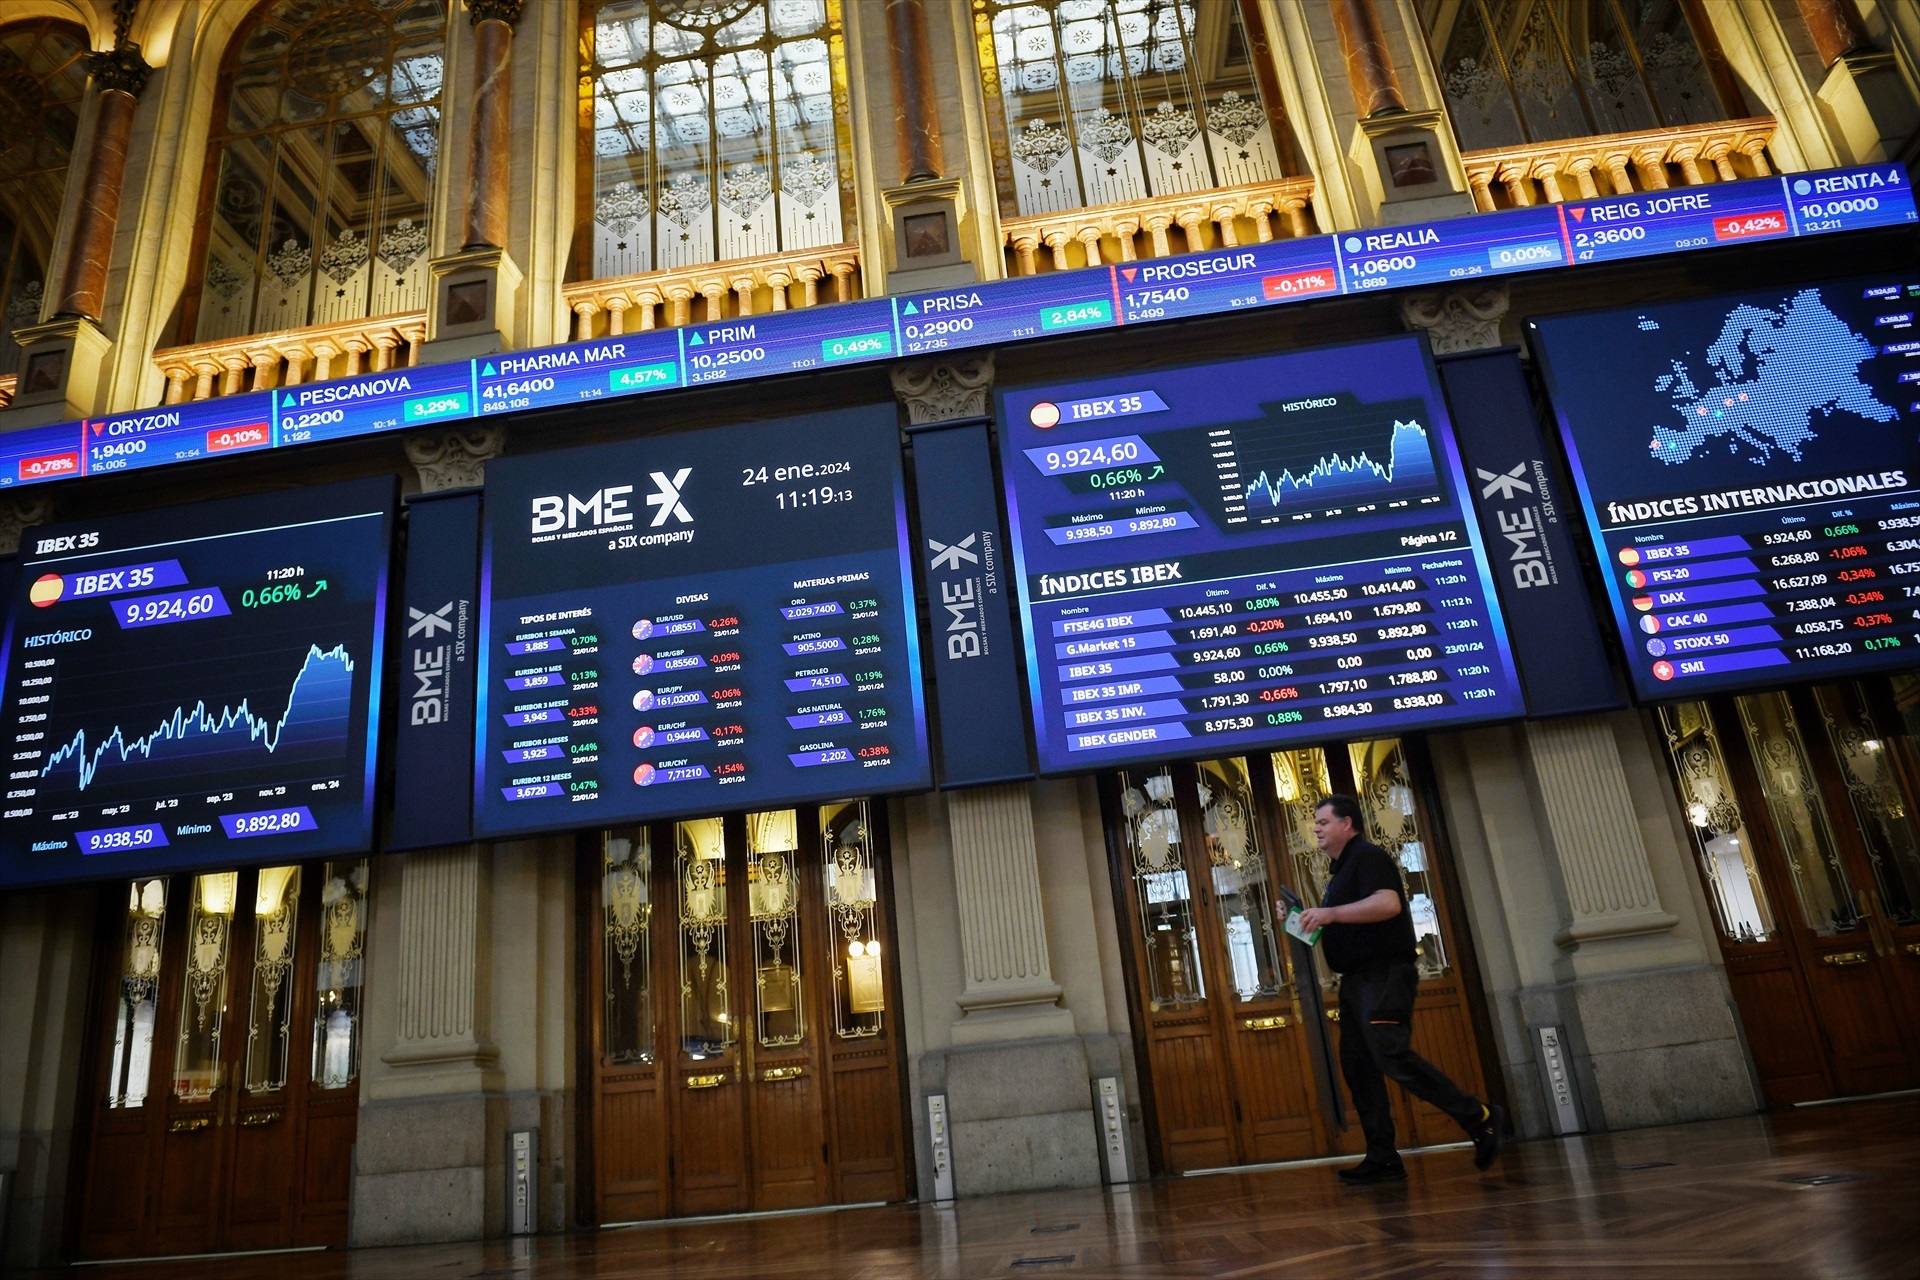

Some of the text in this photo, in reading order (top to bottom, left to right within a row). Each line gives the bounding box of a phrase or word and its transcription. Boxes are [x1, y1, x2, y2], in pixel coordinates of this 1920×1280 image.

[1814, 169, 1900, 194] RENTA 4
[1590, 193, 1712, 222] REIG JOFRE
[1800, 197, 1879, 218] 10,0000
[1721, 217, 1780, 235] -0,42%
[1804, 219, 1842, 232] 13.211
[1366, 228, 1440, 252] REALIA
[1575, 226, 1646, 248] 2,3600
[1675, 237, 1708, 248] 09:00
[1500, 246, 1552, 264] 0,00%
[1579, 250, 1594, 260] 47
[1142, 253, 1256, 282] PROSEGUR
[1349, 256, 1416, 277] 1,0600
[1449, 266, 1482, 277] 09:24
[1273, 275, 1326, 293] -0,11%
[923, 292, 983, 314] PRISA
[1126, 286, 1190, 308] 1,7540
[1051, 307, 1102, 325] 2,84%
[1128, 307, 1165, 321] 5.499
[708, 325, 756, 344] PRIM
[905, 317, 974, 339] 0,2900
[833, 338, 881, 355] 0,49%
[908, 338, 949, 352] 12.735
[500, 344, 626, 375] PHARMA MAR
[690, 347, 765, 369] 10,2500
[620, 369, 667, 385] 4,57%
[692, 369, 727, 382] 3.582
[300, 376, 411, 406] PESCANOVA
[482, 377, 554, 399] 41,6400
[414, 399, 460, 416] 3,29%
[1071, 397, 1142, 419] IBEX 35
[1282, 397, 1337, 412] HISTÓRICO
[108, 412, 180, 436] ORYZON
[282, 409, 344, 431] 0,2200
[214, 430, 262, 447] -0,10%
[91, 440, 147, 461] 1,9400
[1046, 442, 1138, 470] 9.924,60
[25, 459, 73, 474] -0,78%
[742, 466, 769, 486] 24
[1090, 469, 1142, 489] 0,66%
[1532, 460, 1550, 499] company
[776, 486, 853, 510] 11:19:13
[1109, 488, 1145, 501] 11:20 h
[1607, 470, 1908, 524] ÍNDICES INTERNACIONALES
[532, 485, 633, 534] BME
[1135, 505, 1166, 515] Mínimo
[1542, 501, 1555, 516] SIX
[1071, 513, 1104, 524] Máximo
[1129, 517, 1176, 532] 9.892,80
[1066, 525, 1113, 540] 9.938,50
[1634, 534, 1664, 543] Nombre
[1763, 529, 1812, 545] 9.924,60
[1824, 524, 1859, 538] 0,66%
[35, 532, 99, 554] IBEX 35
[608, 529, 694, 550] a SIX company
[1400, 530, 1457, 549] Página 1/2
[982, 531, 995, 572] company
[1497, 507, 1550, 589] BME
[1645, 545, 1690, 560] IBEX 35
[1829, 545, 1867, 560] -1,06%
[1771, 551, 1820, 567] 6.268,80
[74, 567, 154, 595] IBEX 35
[267, 566, 304, 580] 11:20 h
[793, 572, 870, 589] MATERIAS PRIMAS
[986, 572, 997, 588] SIX
[1040, 562, 1182, 596] ÍNDICES IBEX
[1652, 568, 1690, 582] PSI-20
[1773, 574, 1828, 590] 16.627,09
[242, 583, 302, 608] 0,66%
[676, 593, 709, 604] DIVISAS
[791, 598, 806, 606] ORO
[1659, 591, 1686, 604] DAX
[127, 594, 213, 623] 9.924,60
[788, 604, 836, 618] 2.029,7400
[850, 599, 877, 610] 0,37%
[1179, 602, 1233, 618] 10.445,10
[1246, 597, 1280, 611] 0,80%
[1786, 596, 1836, 612] 7.388,04
[457, 599, 469, 640] company
[520, 607, 592, 625] TIPOS DE INTERÉS
[656, 614, 684, 623] EUR/USD
[941, 578, 980, 660] BME
[1063, 615, 1133, 633] FTSE4G IBEX
[1666, 613, 1708, 627] CAC 40
[1189, 624, 1237, 640] 1.691,40
[1795, 619, 1844, 635] 4.058,75
[24, 628, 92, 648] HISTÓRICO
[793, 632, 821, 641] PLATINO
[1673, 634, 1730, 650] STOXX 50
[1864, 637, 1901, 651] 0,17%
[455, 640, 466, 656] SIX
[797, 640, 839, 653] 905,5000
[1066, 637, 1136, 655] G.Market 15
[1444, 641, 1484, 655] 23/01/24
[1796, 642, 1852, 659] 11.168,20
[1193, 647, 1241, 662] 9.924,60
[795, 668, 829, 677] PETROLEO
[1069, 663, 1112, 678] IBEX 35
[1680, 660, 1706, 674] SMI
[571, 670, 598, 681] 0,13%
[811, 676, 841, 687] 74,510
[411, 645, 444, 726] BME
[1072, 683, 1143, 701] IBEX 35 IMP.
[1201, 693, 1249, 709] 1.791,30
[1259, 687, 1298, 702] -0,66%
[812, 703, 842, 712] NATURAL
[1076, 706, 1147, 724] IBEX 35 INV.
[523, 712, 548, 723] 3,945
[819, 713, 844, 724] 2,493
[1205, 716, 1253, 732] 8.975,30
[1079, 728, 1157, 748] IBEX GENDER
[799, 742, 834, 752] GASOLINA
[821, 751, 847, 762] 2,202
[667, 768, 702, 780] 7,71210
[177, 824, 212, 836] Mínimo
[235, 812, 300, 834] 9.892,80
[32, 841, 68, 853] Máximo
[90, 829, 152, 850] 9.938,50
